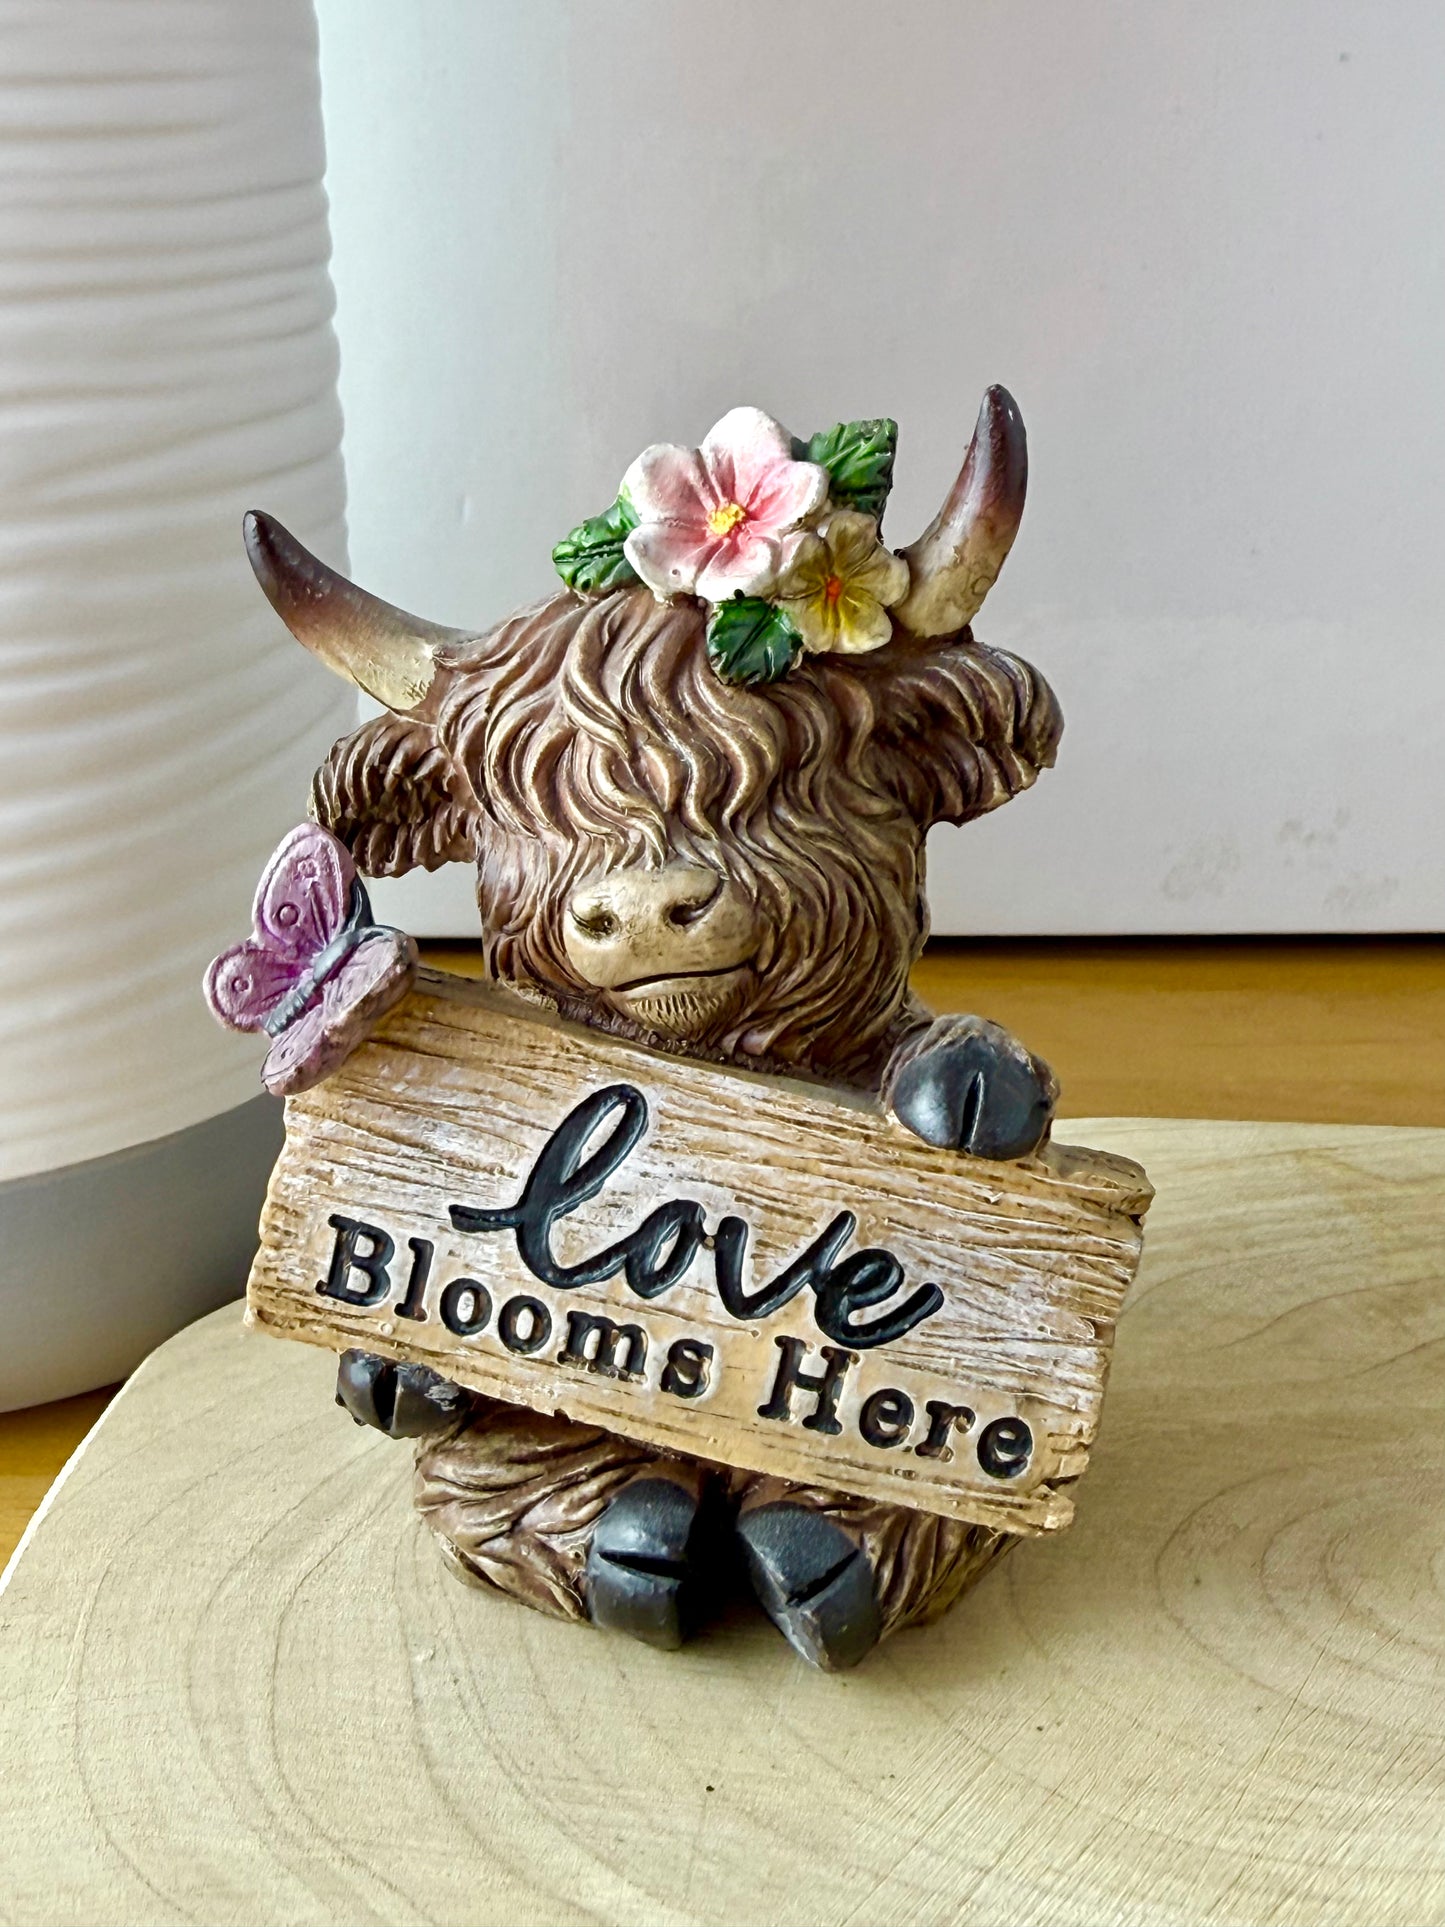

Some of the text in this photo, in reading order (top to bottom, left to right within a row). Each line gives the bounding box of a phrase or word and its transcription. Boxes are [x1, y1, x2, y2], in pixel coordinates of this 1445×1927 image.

[315, 1213, 1033, 1479] Blooms Here
[449, 1083, 944, 1349] love
